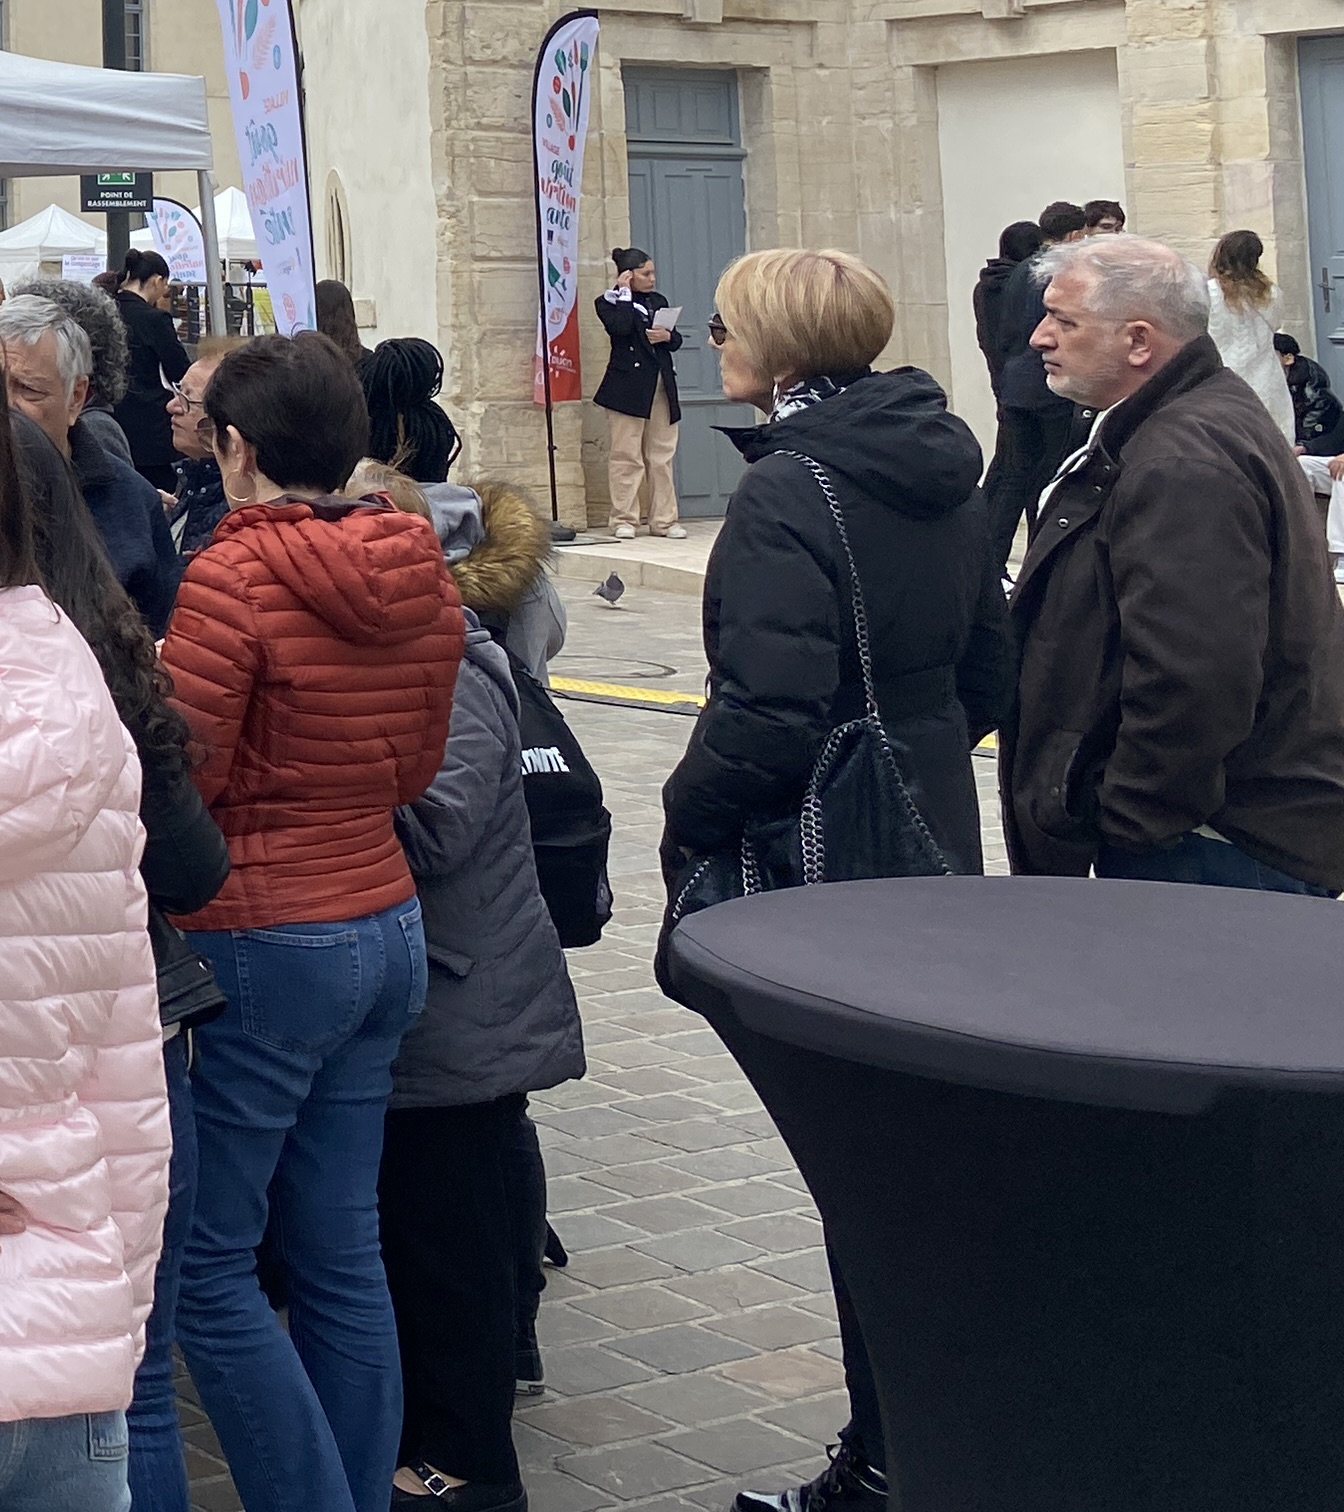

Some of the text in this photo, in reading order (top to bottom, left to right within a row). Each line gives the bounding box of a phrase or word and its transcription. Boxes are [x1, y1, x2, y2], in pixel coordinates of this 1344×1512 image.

[551, 159, 574, 188] goût
[541, 177, 576, 213] utrition
[546, 207, 570, 231] anté
